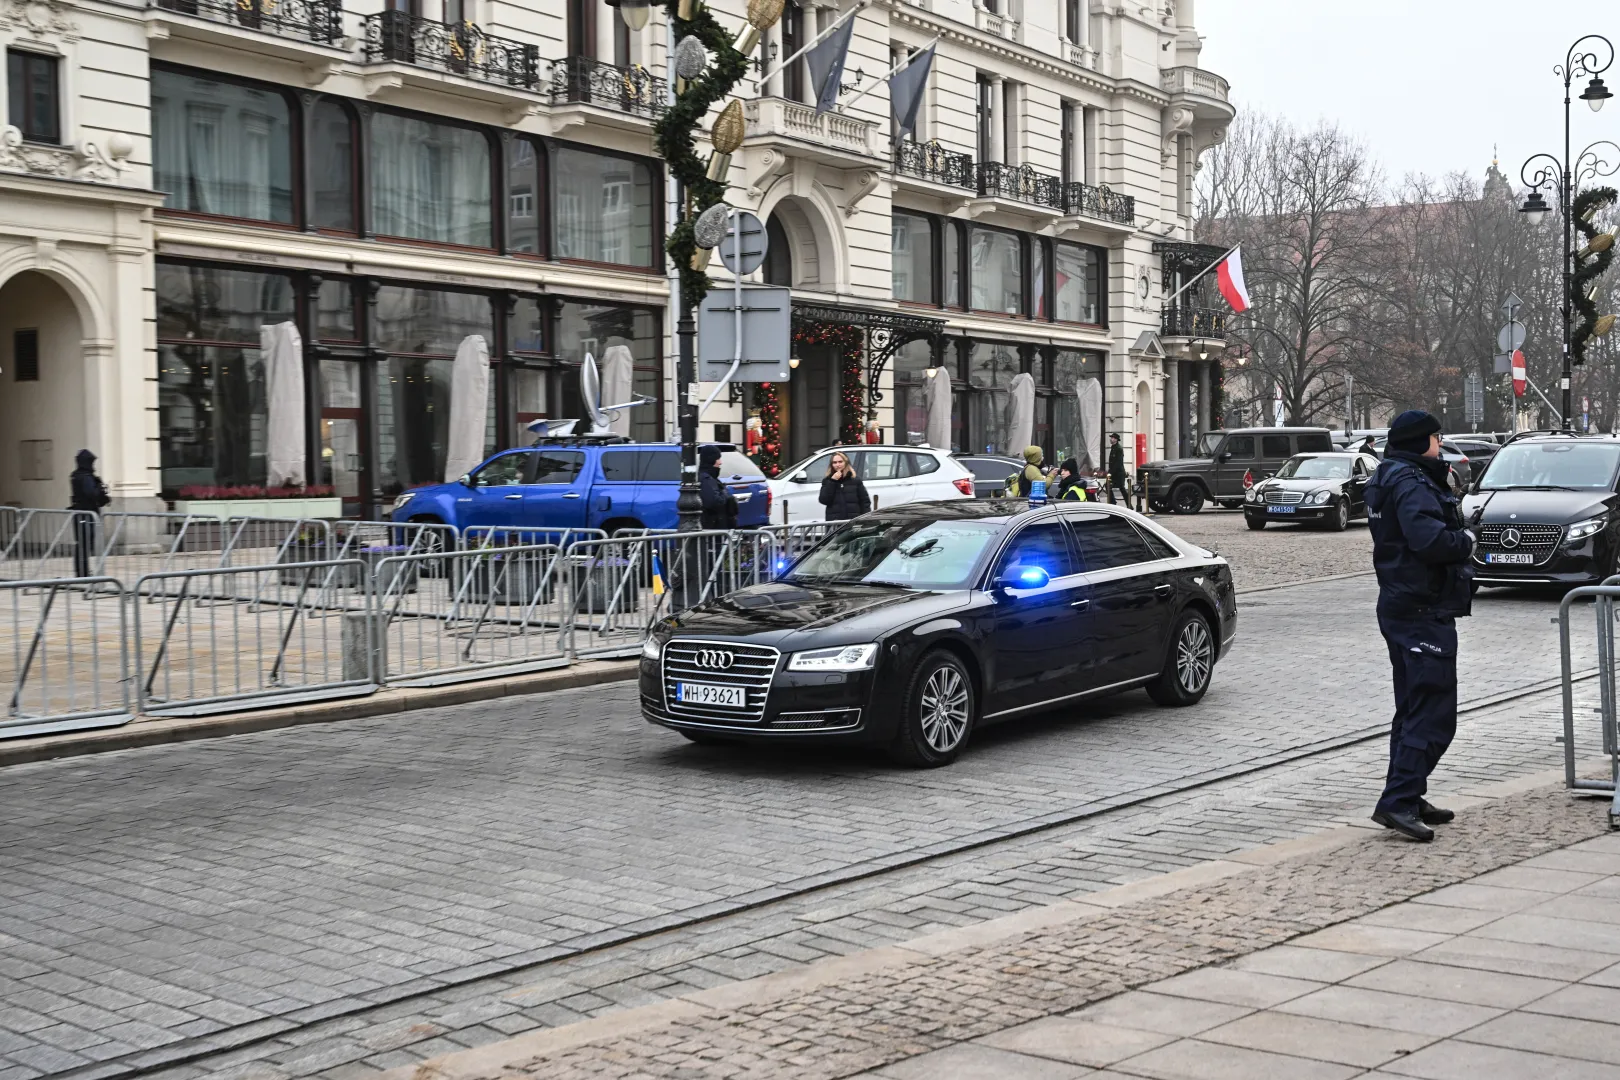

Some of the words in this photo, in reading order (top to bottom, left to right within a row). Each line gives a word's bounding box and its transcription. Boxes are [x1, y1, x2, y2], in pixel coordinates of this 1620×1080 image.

[1491, 554, 1502, 563] WE
[1504, 554, 1531, 563] 9EA01
[684, 685, 699, 701] WH
[703, 687, 740, 705] 93621
